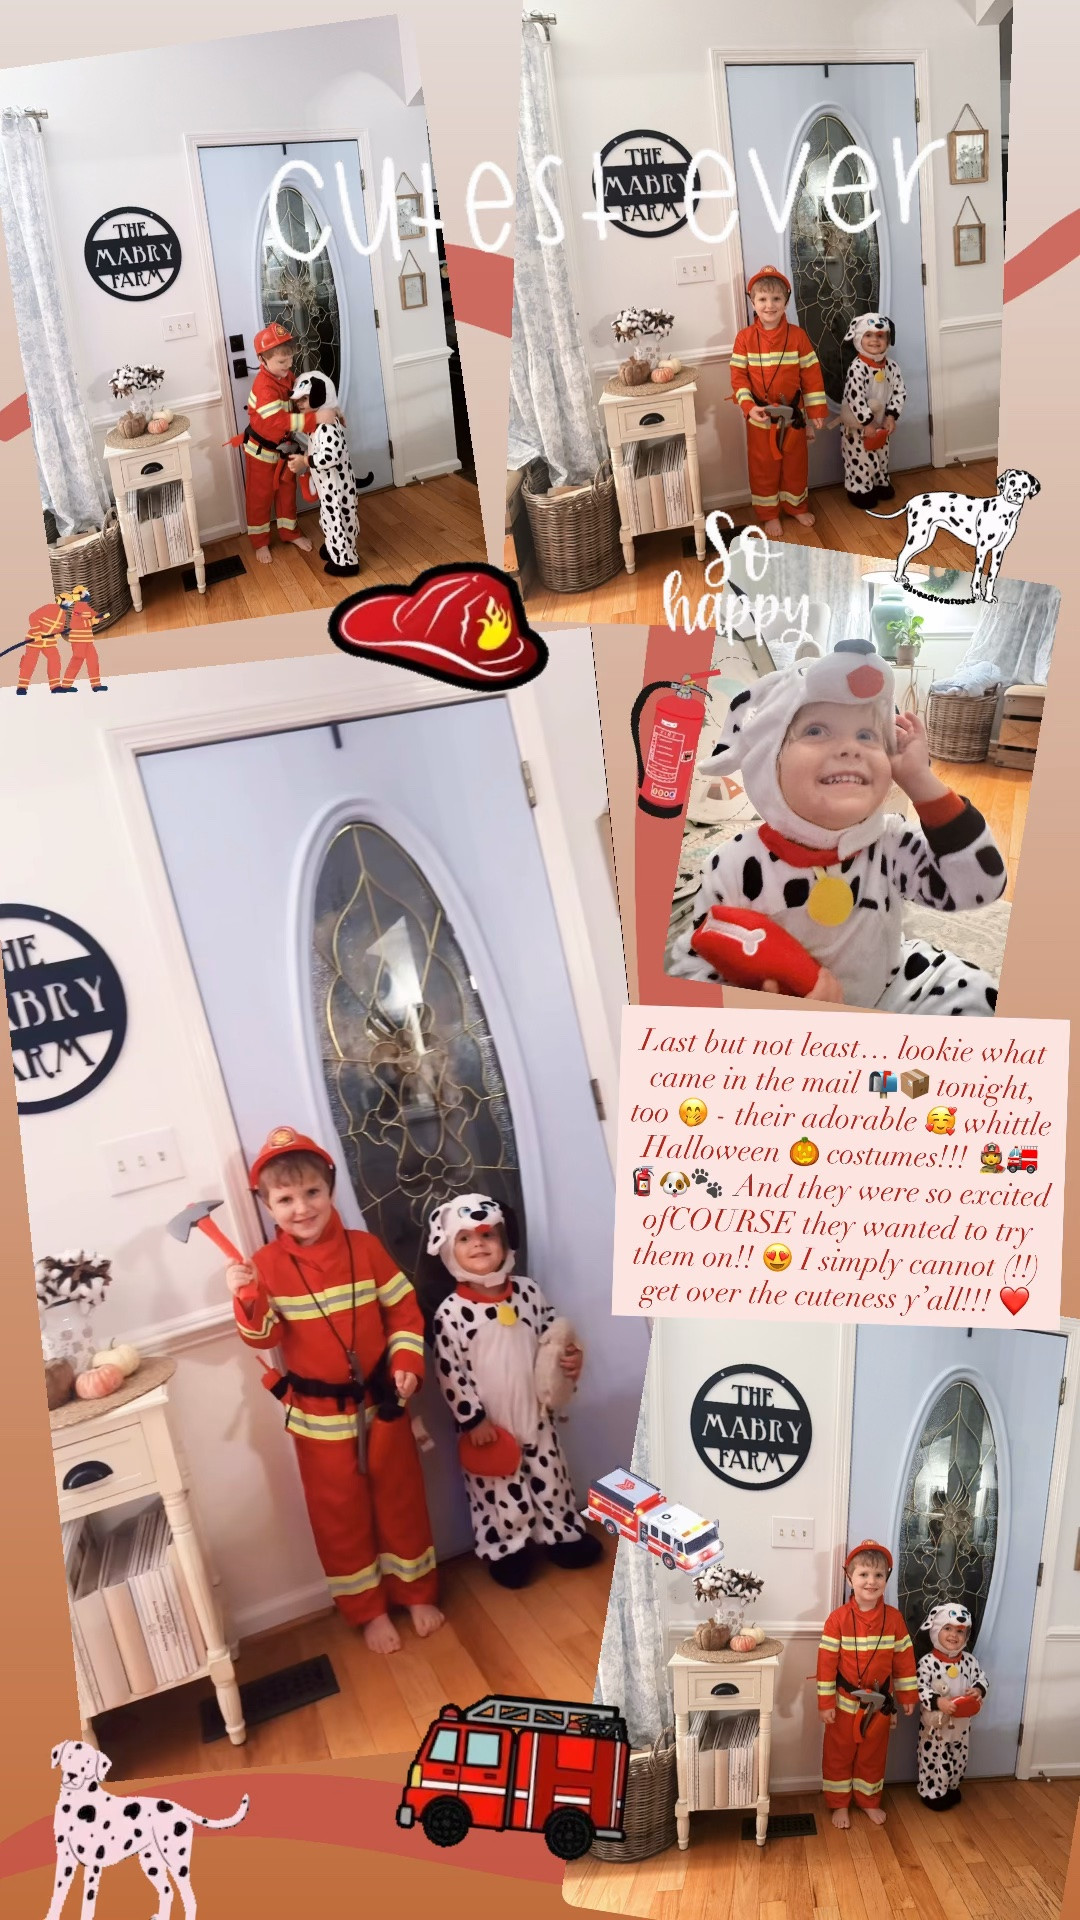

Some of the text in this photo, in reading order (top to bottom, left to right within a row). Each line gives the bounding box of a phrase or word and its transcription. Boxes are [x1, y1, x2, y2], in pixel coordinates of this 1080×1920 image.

[625, 148, 664, 165] THE
[621, 203, 681, 221] FARM
[113, 222, 148, 239] THE
[95, 243, 172, 267] MABRY
[111, 269, 165, 288] FARM
[1, 934, 45, 969] HE
[732, 1384, 774, 1408] THE
[702, 1413, 802, 1444] MABRY
[719, 1448, 785, 1473] FARM
